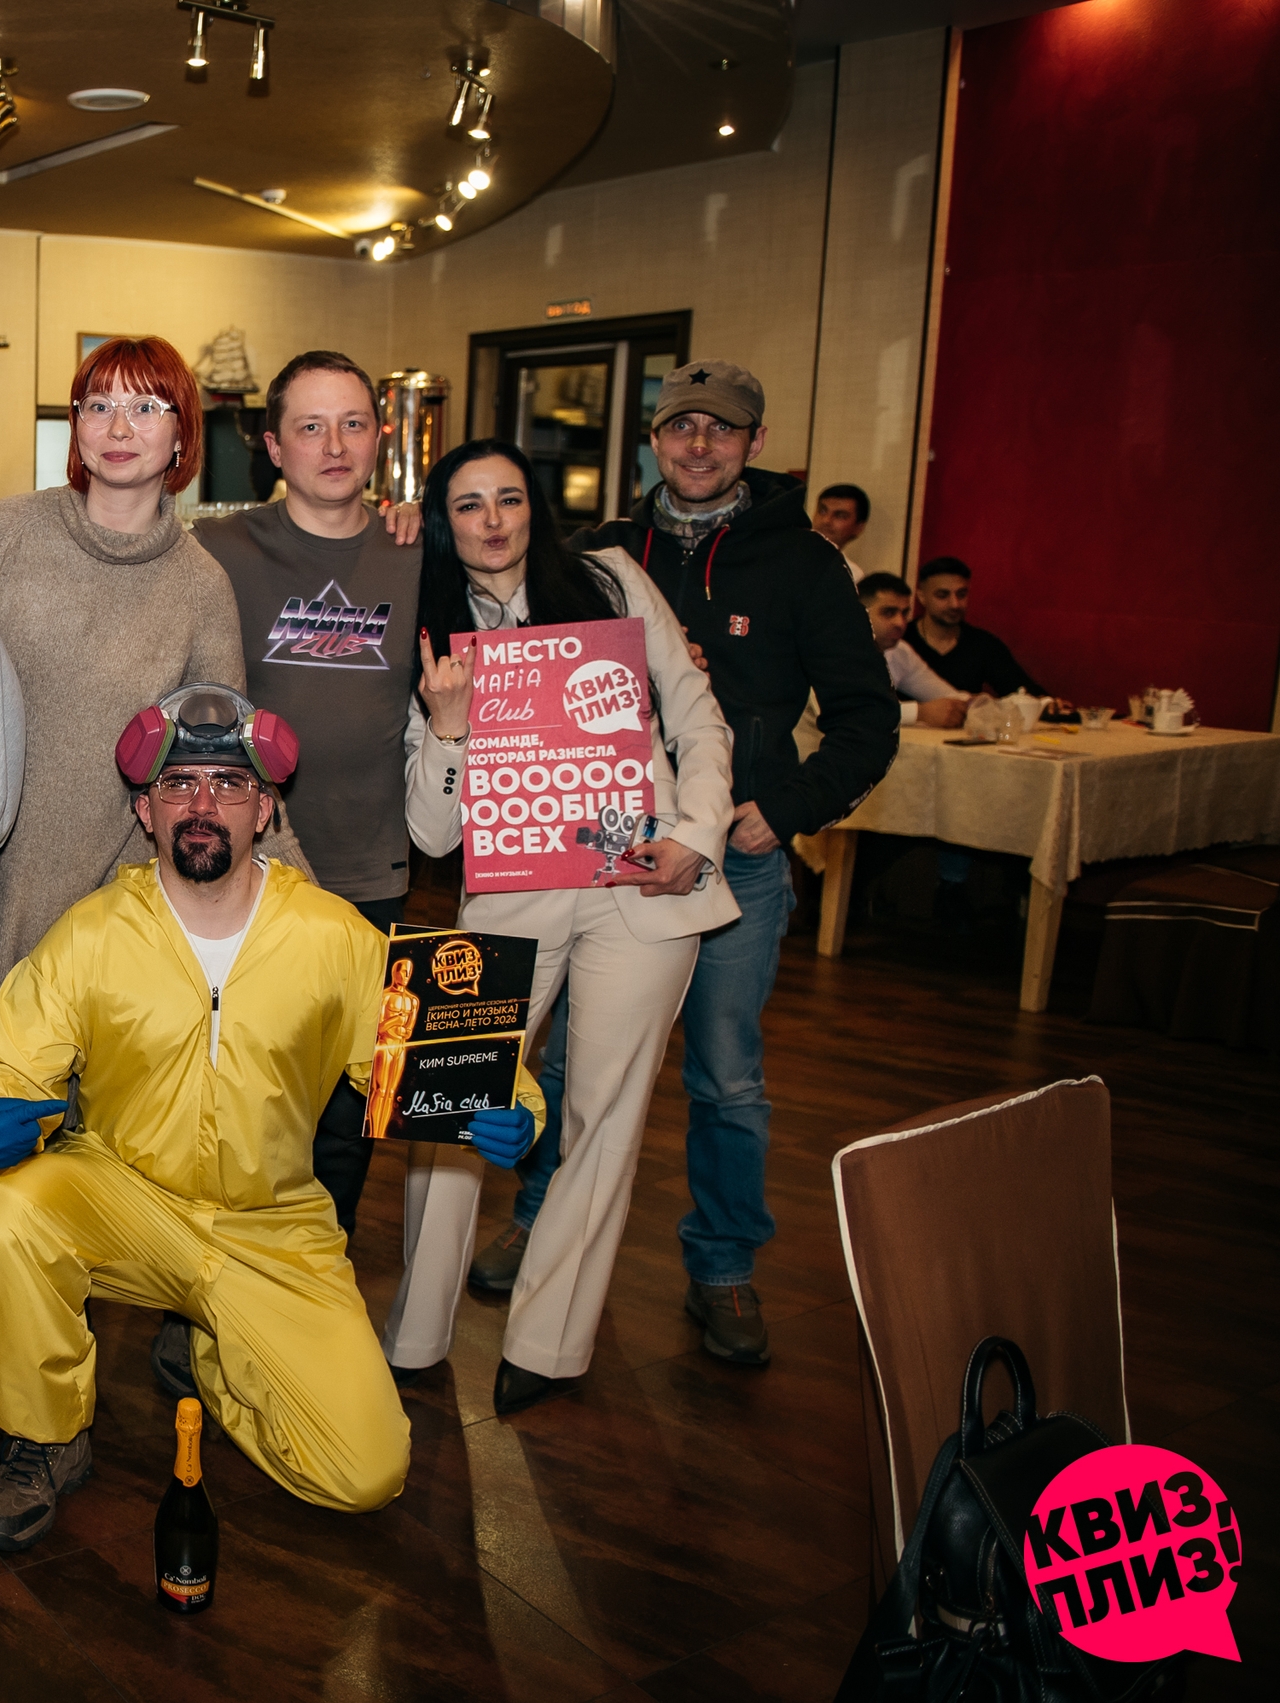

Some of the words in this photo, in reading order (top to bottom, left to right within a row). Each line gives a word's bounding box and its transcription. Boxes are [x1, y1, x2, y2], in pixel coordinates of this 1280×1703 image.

[483, 636, 582, 666] МЕСТО
[564, 668, 636, 705] КВИЗ,
[479, 698, 535, 722] Club
[568, 686, 641, 724] ПЛИЗ!
[468, 734, 544, 750] КОМАНДЕ,
[468, 750, 536, 766] КОТОРАЯ
[539, 745, 617, 761] РАЗНЕСЛА
[469, 759, 654, 796] ВООООО
[460, 790, 644, 826] ОООБЩЕ
[473, 825, 567, 856] ВСЕХ
[425, 1017, 491, 1031] ВЕСНА-ЛЕТО
[493, 1015, 517, 1025] 2026
[427, 1010, 460, 1022] [КИНО
[463, 1009, 470, 1017] И
[473, 1003, 519, 1016] МУЗЫКА]
[419, 1057, 445, 1069] КИМ
[446, 1051, 499, 1066] SUPREME
[163, 1582, 207, 1594] PROSECCO
